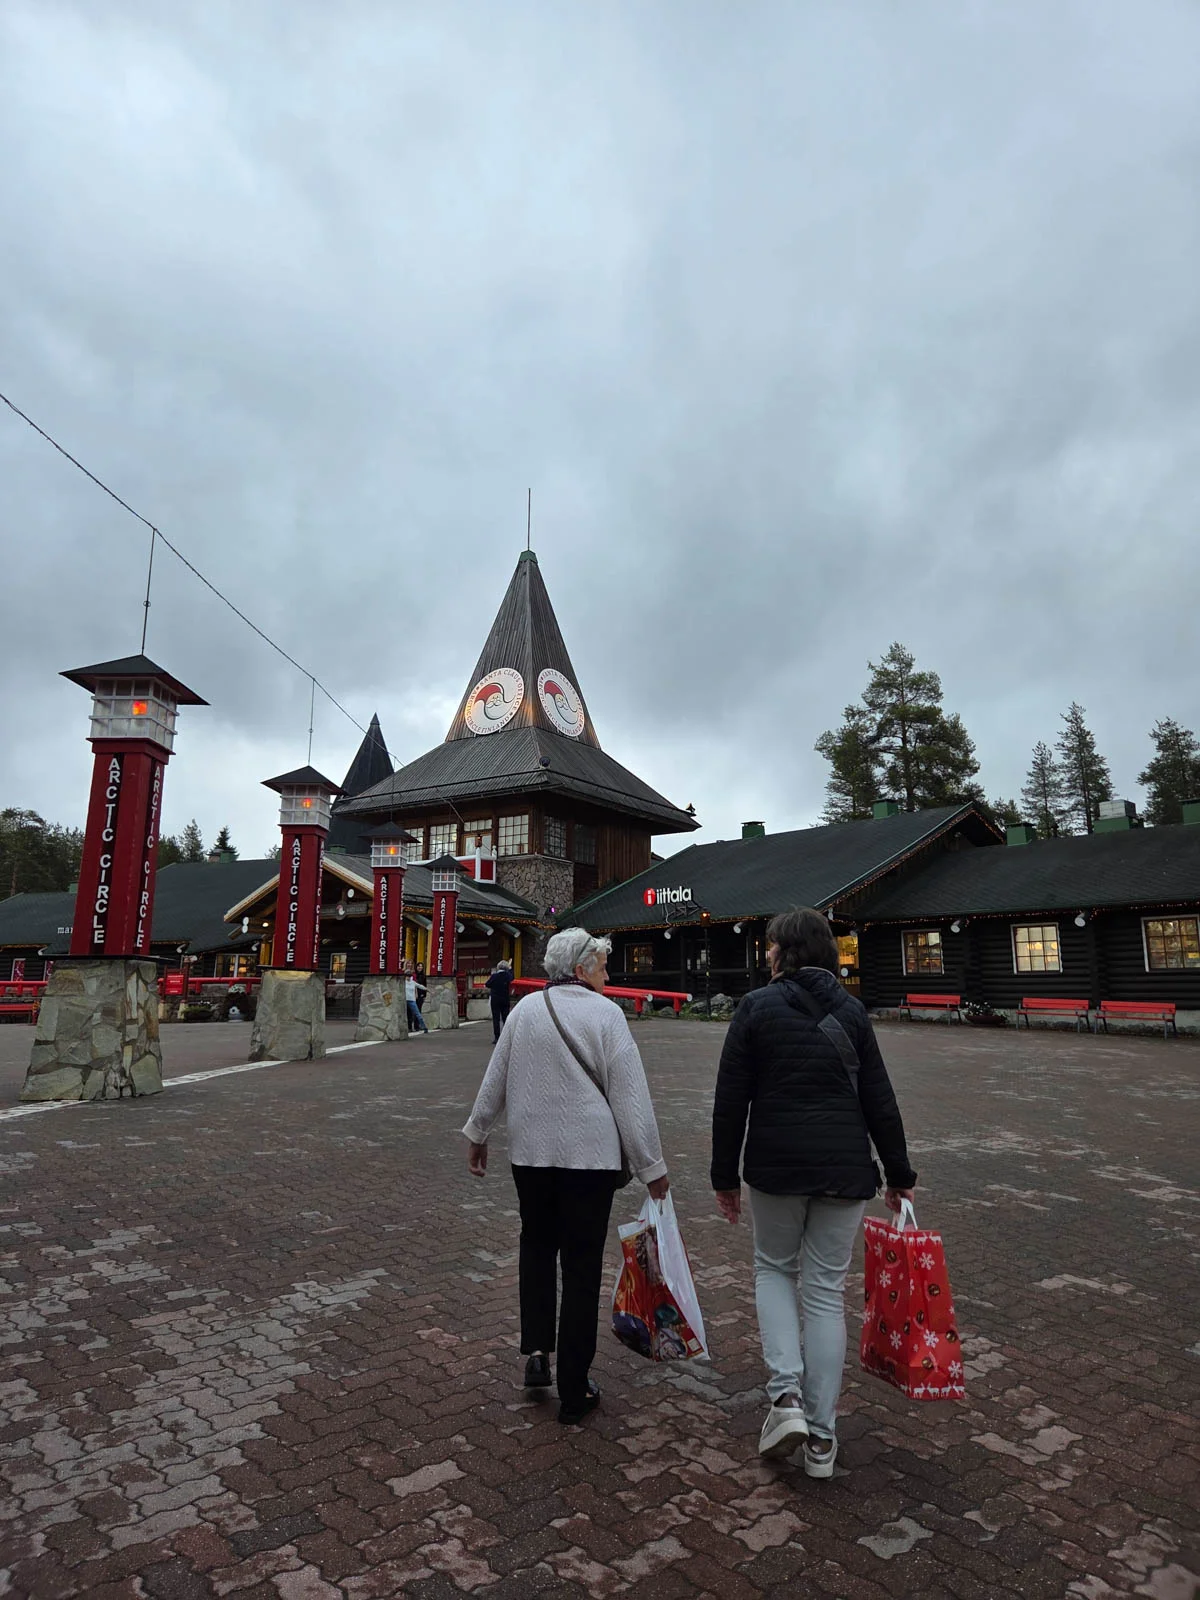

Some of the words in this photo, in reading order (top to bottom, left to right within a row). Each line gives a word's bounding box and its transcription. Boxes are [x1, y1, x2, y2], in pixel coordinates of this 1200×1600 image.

[102, 757, 121, 842] ARCTIC
[147, 765, 161, 849] ARCTIC
[289, 838, 301, 895] ARCTIC
[656, 885, 692, 905] iittala
[93, 854, 112, 944] CIRCLE
[136, 860, 150, 948] CIRCLE
[379, 876, 388, 920] ARCTIC
[286, 902, 298, 962] CIRCLE
[379, 925, 387, 969] CIRCLE
